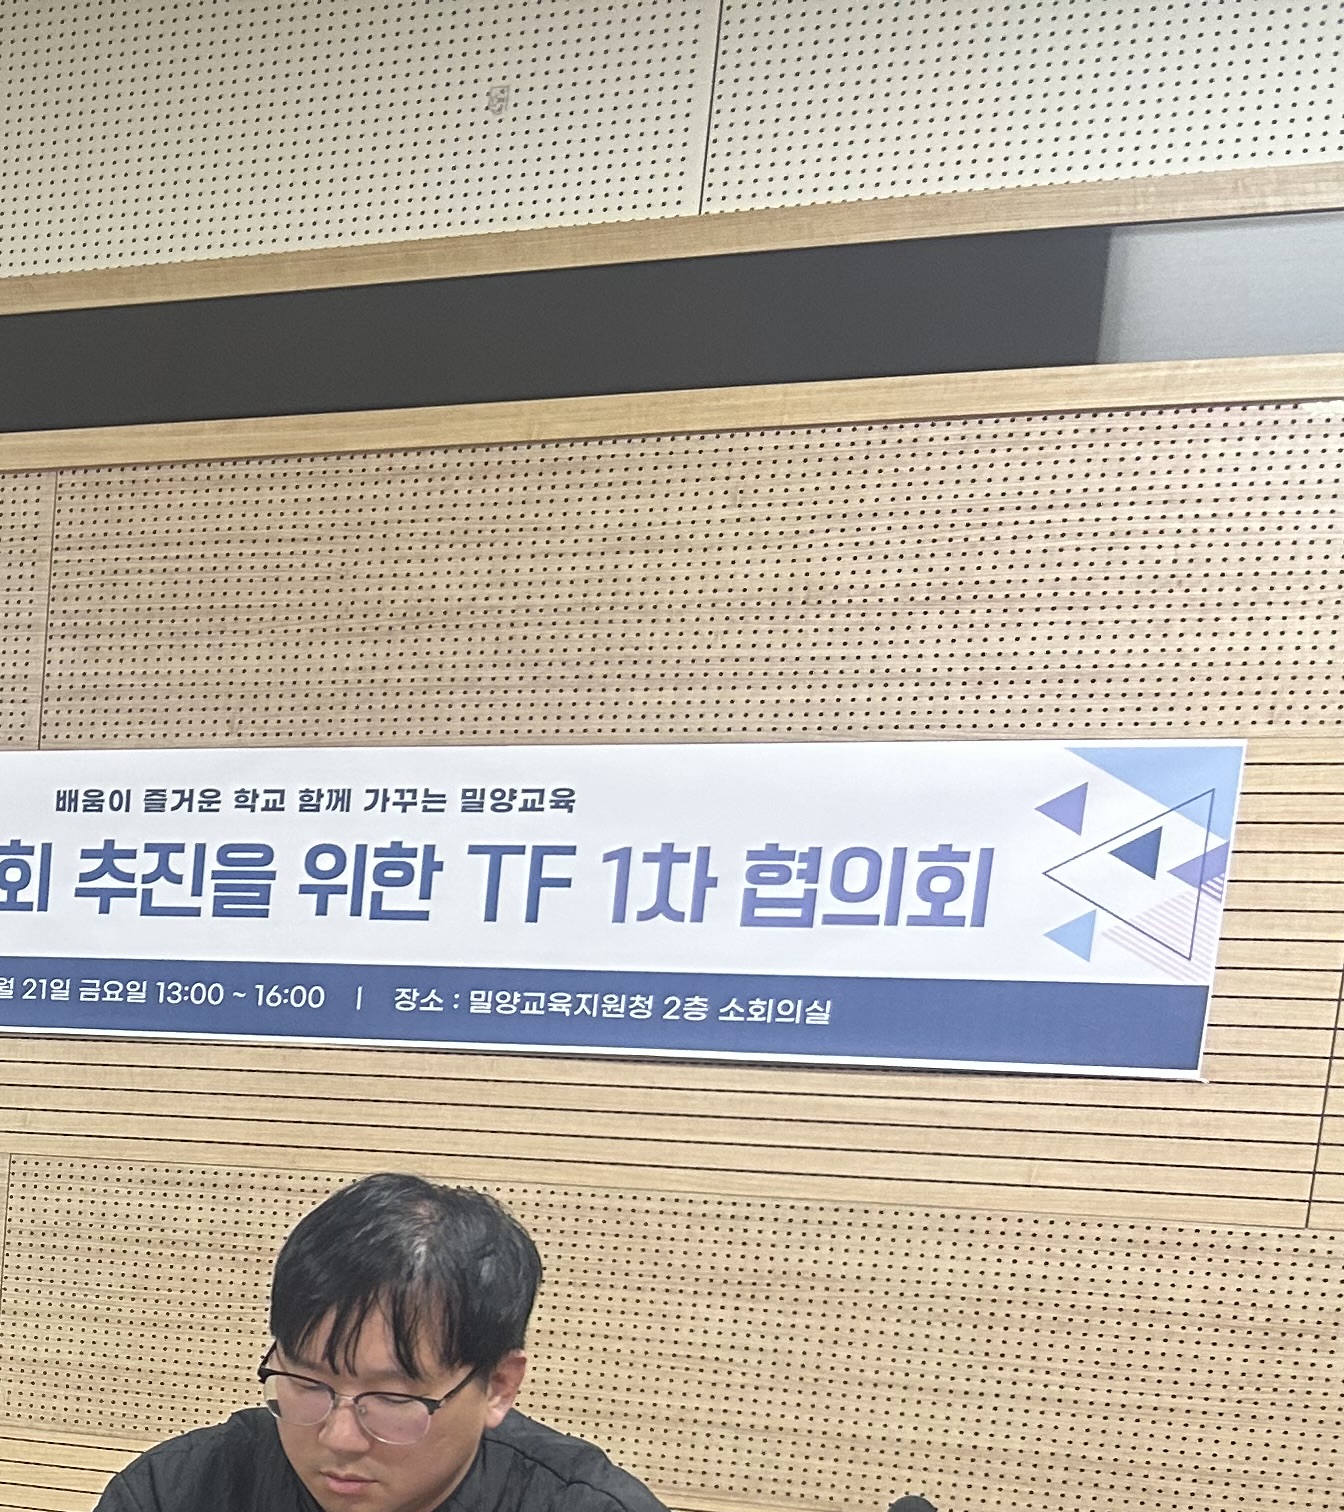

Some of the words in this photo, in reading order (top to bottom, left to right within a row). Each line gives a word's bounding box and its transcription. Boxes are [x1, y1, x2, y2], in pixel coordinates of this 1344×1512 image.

[55, 787, 131, 813] 배움이
[143, 787, 222, 814] 즐거운
[234, 787, 286, 814] 학교
[298, 787, 352, 814] 함께
[363, 787, 447, 815] 가꾸는
[460, 787, 576, 815] 밀양교육
[73, 838, 277, 920] 추진을
[298, 840, 444, 922] 위한
[467, 843, 577, 924] TF
[602, 842, 719, 925] 1차
[739, 842, 996, 930] 협의회
[22, 977, 71, 1002] 21일
[78, 978, 147, 1004] 금요일
[156, 980, 224, 1006] 13:00
[255, 983, 325, 1010] 16:00
[394, 987, 444, 1012] 장소
[469, 990, 654, 1021] 밀양교육지원청
[662, 997, 709, 1023] 2층
[718, 1000, 832, 1027] 소회의실
